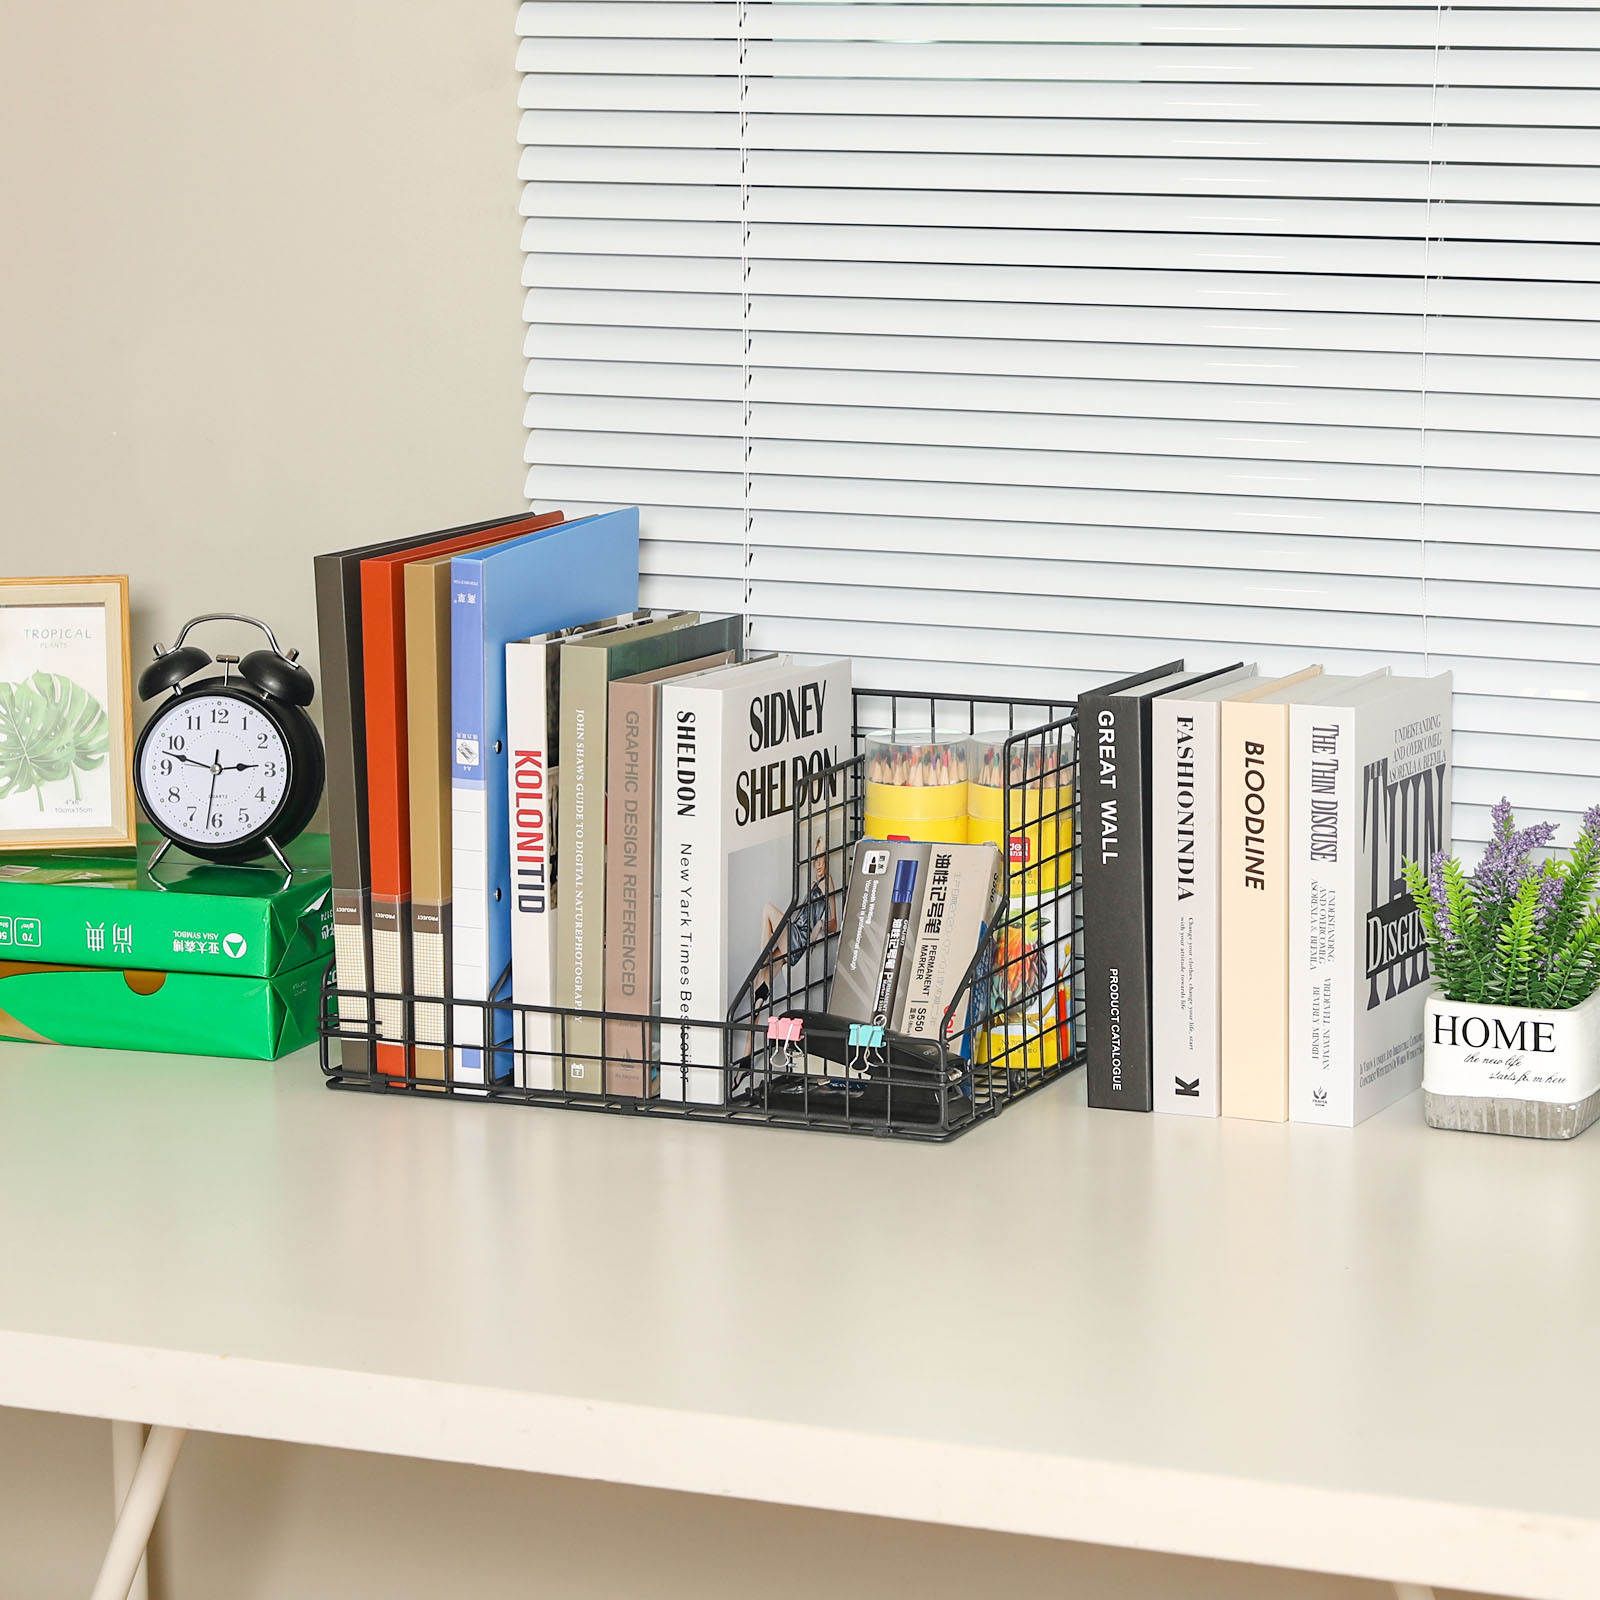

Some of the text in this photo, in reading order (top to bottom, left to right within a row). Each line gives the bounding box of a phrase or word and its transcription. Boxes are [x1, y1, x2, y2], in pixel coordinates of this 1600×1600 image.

[24, 628, 92, 640] TROPICAL
[186, 715, 201, 731] 11
[210, 708, 229, 724] 12
[241, 716, 248, 731] 1
[749, 680, 826, 752] SIDNEY
[168, 735, 185, 751] 10
[257, 733, 268, 749] 2
[1311, 724, 1339, 755] THE
[160, 759, 172, 776] 9
[264, 762, 276, 777] 3
[677, 711, 696, 817] SHELDON
[1311, 758, 1338, 795] THIN
[168, 786, 181, 803] 8
[254, 786, 267, 802] 4
[735, 745, 837, 826] SHELDON
[1097, 710, 1119, 865] GREAT WALL
[186, 806, 197, 822] 7
[238, 807, 250, 823] 5
[1176, 715, 1195, 901] FASHIONINDIA
[1244, 741, 1265, 891] BLOODLINE
[211, 813, 223, 829] 6
[514, 750, 545, 914] KOLONITID
[574, 708, 585, 1024] JOHN SHAWS GUIDE TO DIGITAL NATUREPHOTOGRAPY
[621, 711, 639, 997] GRAPHIC DESIGN REFERENCED
[680, 843, 692, 882] New
[680, 886, 692, 926] Yark
[865, 880, 879, 925] Smooth Writing
[924, 854, 952, 934] 油性记号笔
[375, 912, 396, 920] PROJECT
[417, 914, 439, 922] PROJECT
[22, 932, 34, 942] 70
[86, 921, 133, 953] 尚典
[172, 930, 219, 940] ASIA SYMBOL
[854, 916, 864, 949] professional
[172, 938, 220, 954] 亚太森博
[680, 932, 692, 985] Times
[850, 949, 858, 971] enough
[916, 944, 929, 981] MARKER
[923, 944, 938, 996] PERMANENT
[915, 1007, 927, 1032] S550
[1109, 968, 1122, 1091] PRODUCT CATALOGUE
[1432, 1013, 1557, 1053] HOME
[1463, 1052, 1481, 1063] the
[1504, 1055, 1525, 1069] life
[1175, 1076, 1200, 1097] K
[1488, 1071, 1516, 1081] starts
[1544, 1071, 1567, 1084] here
